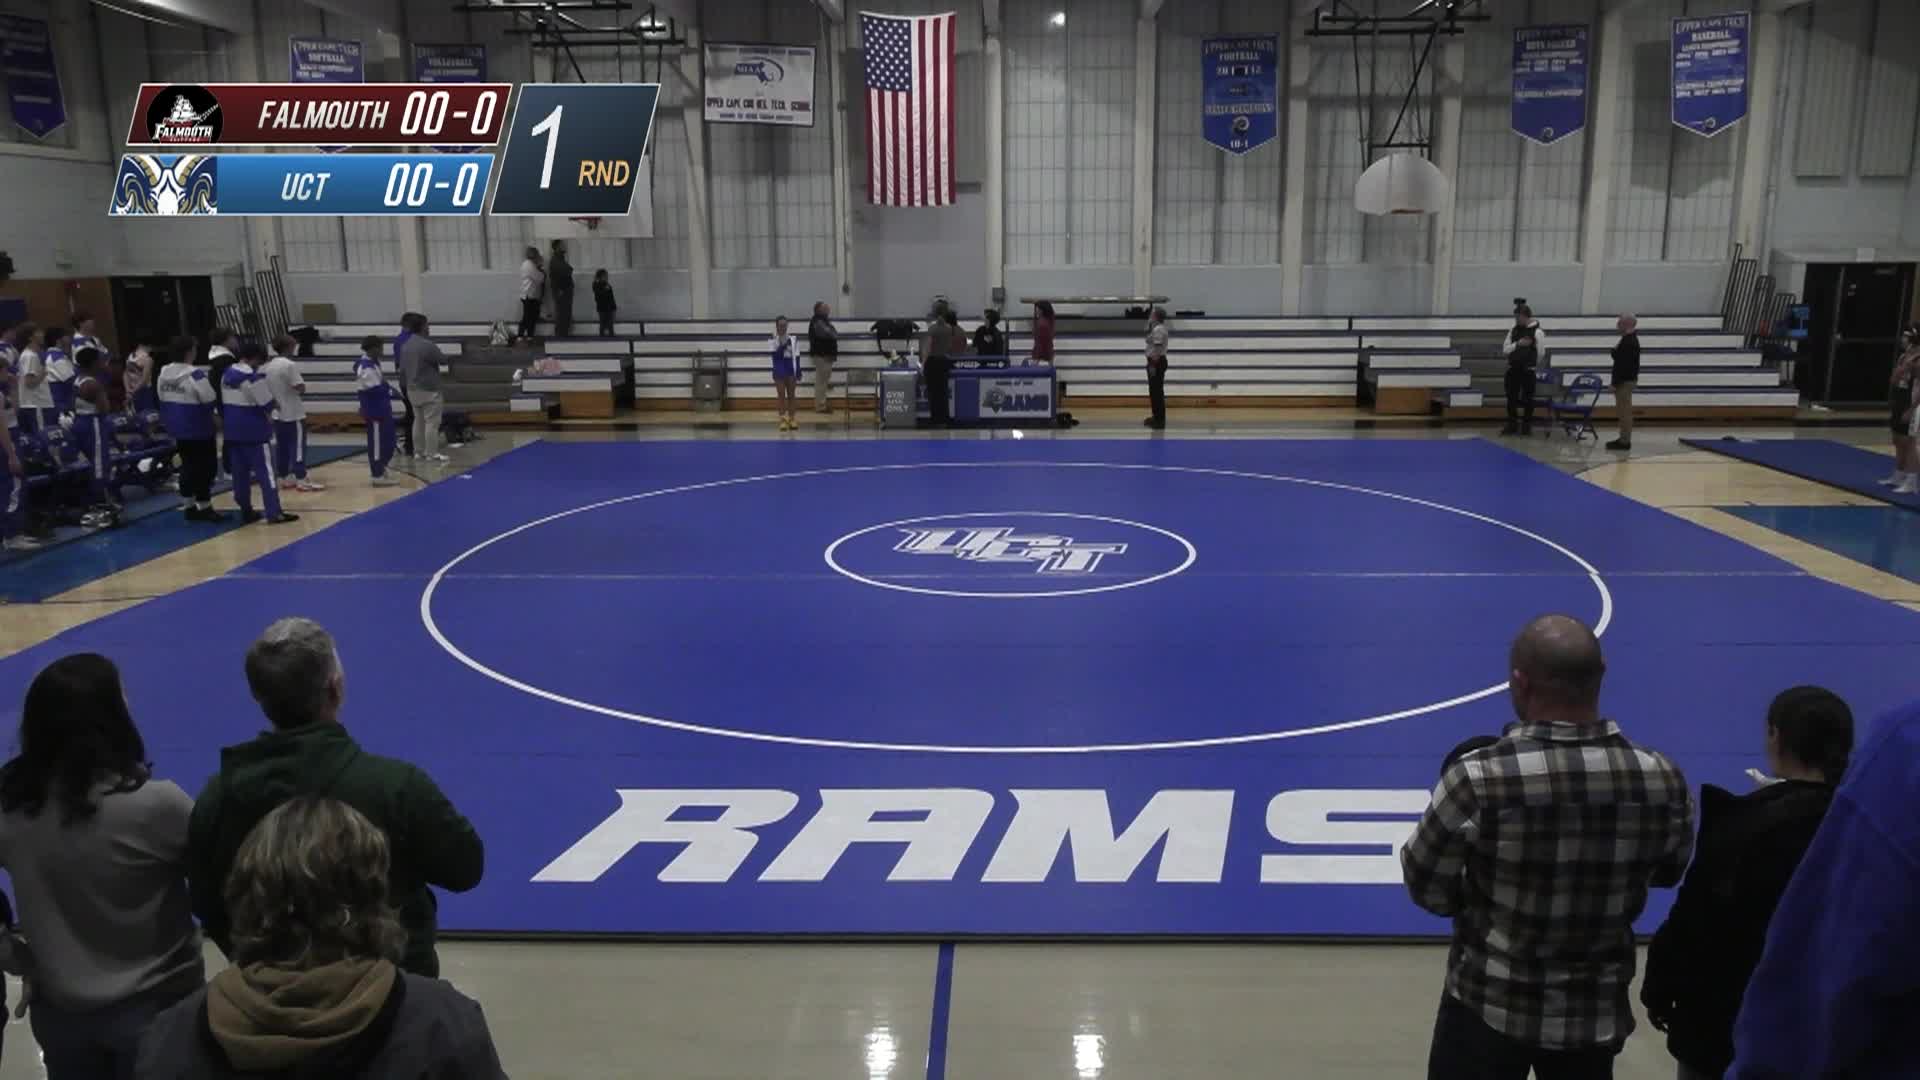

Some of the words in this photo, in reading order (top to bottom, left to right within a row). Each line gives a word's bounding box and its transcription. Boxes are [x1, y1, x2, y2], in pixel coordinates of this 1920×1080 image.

[886, 391, 905, 399] GYM
[891, 527, 1129, 574] UCT
[529, 787, 1434, 884] RAMS
